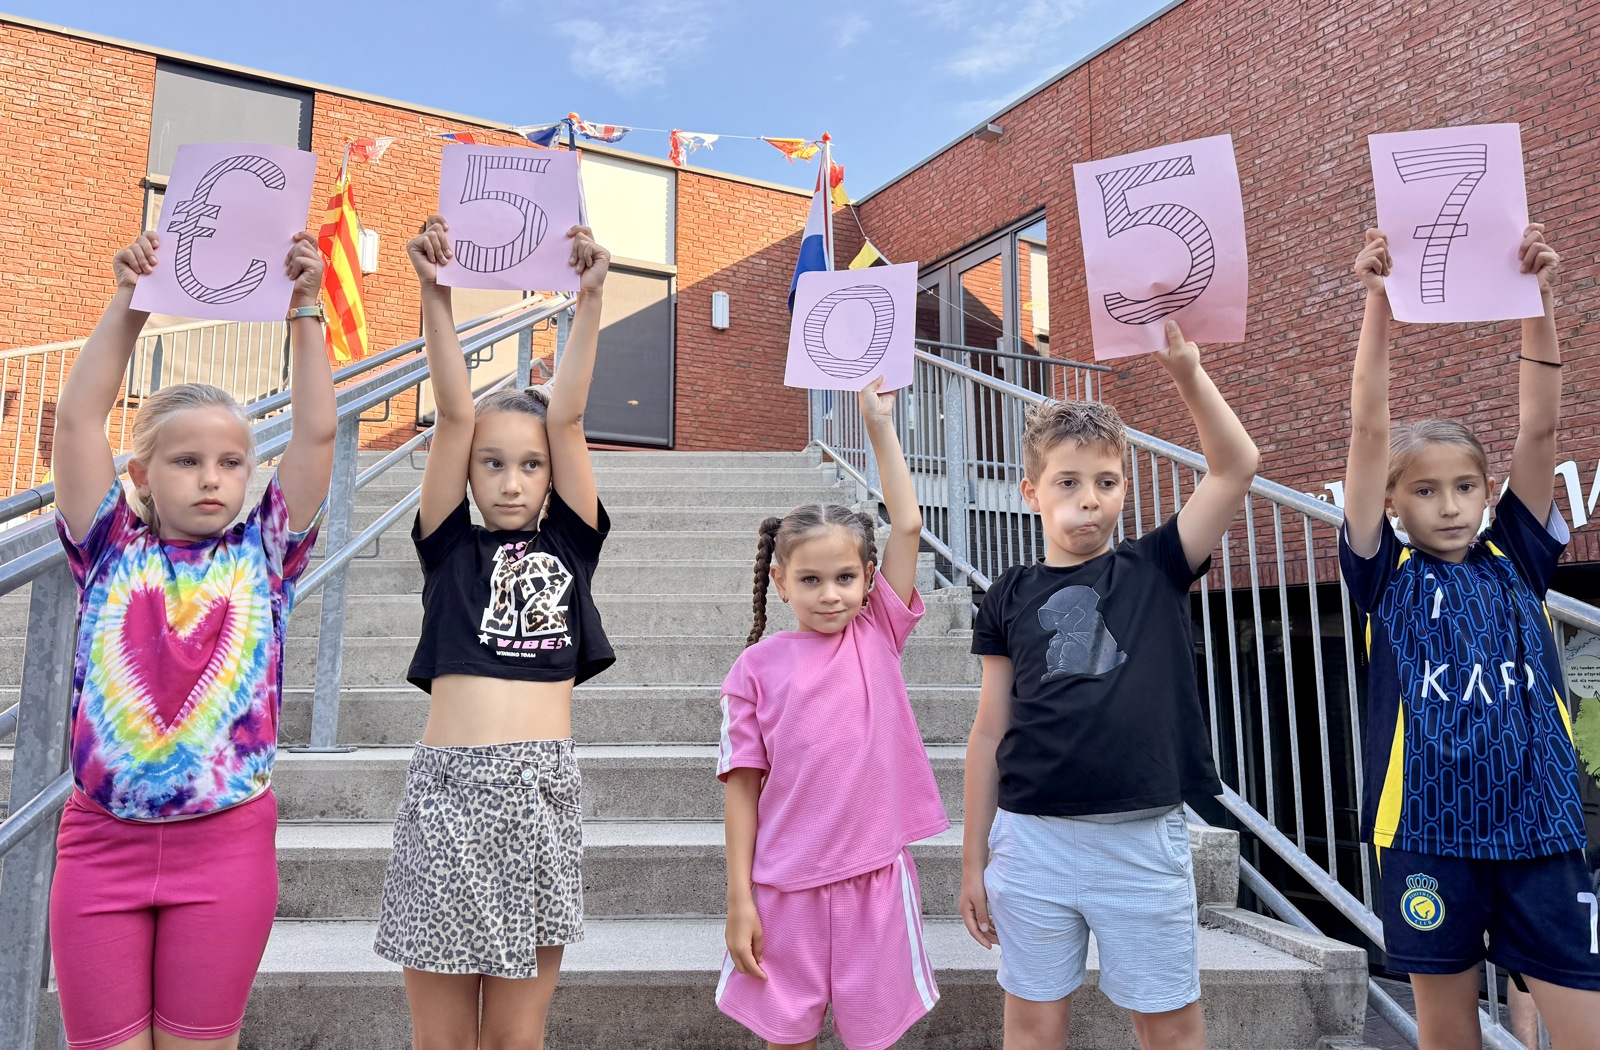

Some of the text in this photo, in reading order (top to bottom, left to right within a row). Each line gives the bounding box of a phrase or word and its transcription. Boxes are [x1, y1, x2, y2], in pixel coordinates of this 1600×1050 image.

[167, 154, 286, 304] €
[455, 154, 551, 273] 5
[1095, 154, 1215, 325] 5
[1391, 143, 1488, 304] 7
[480, 545, 573, 637] 12
[496, 637, 563, 650] VIBES
